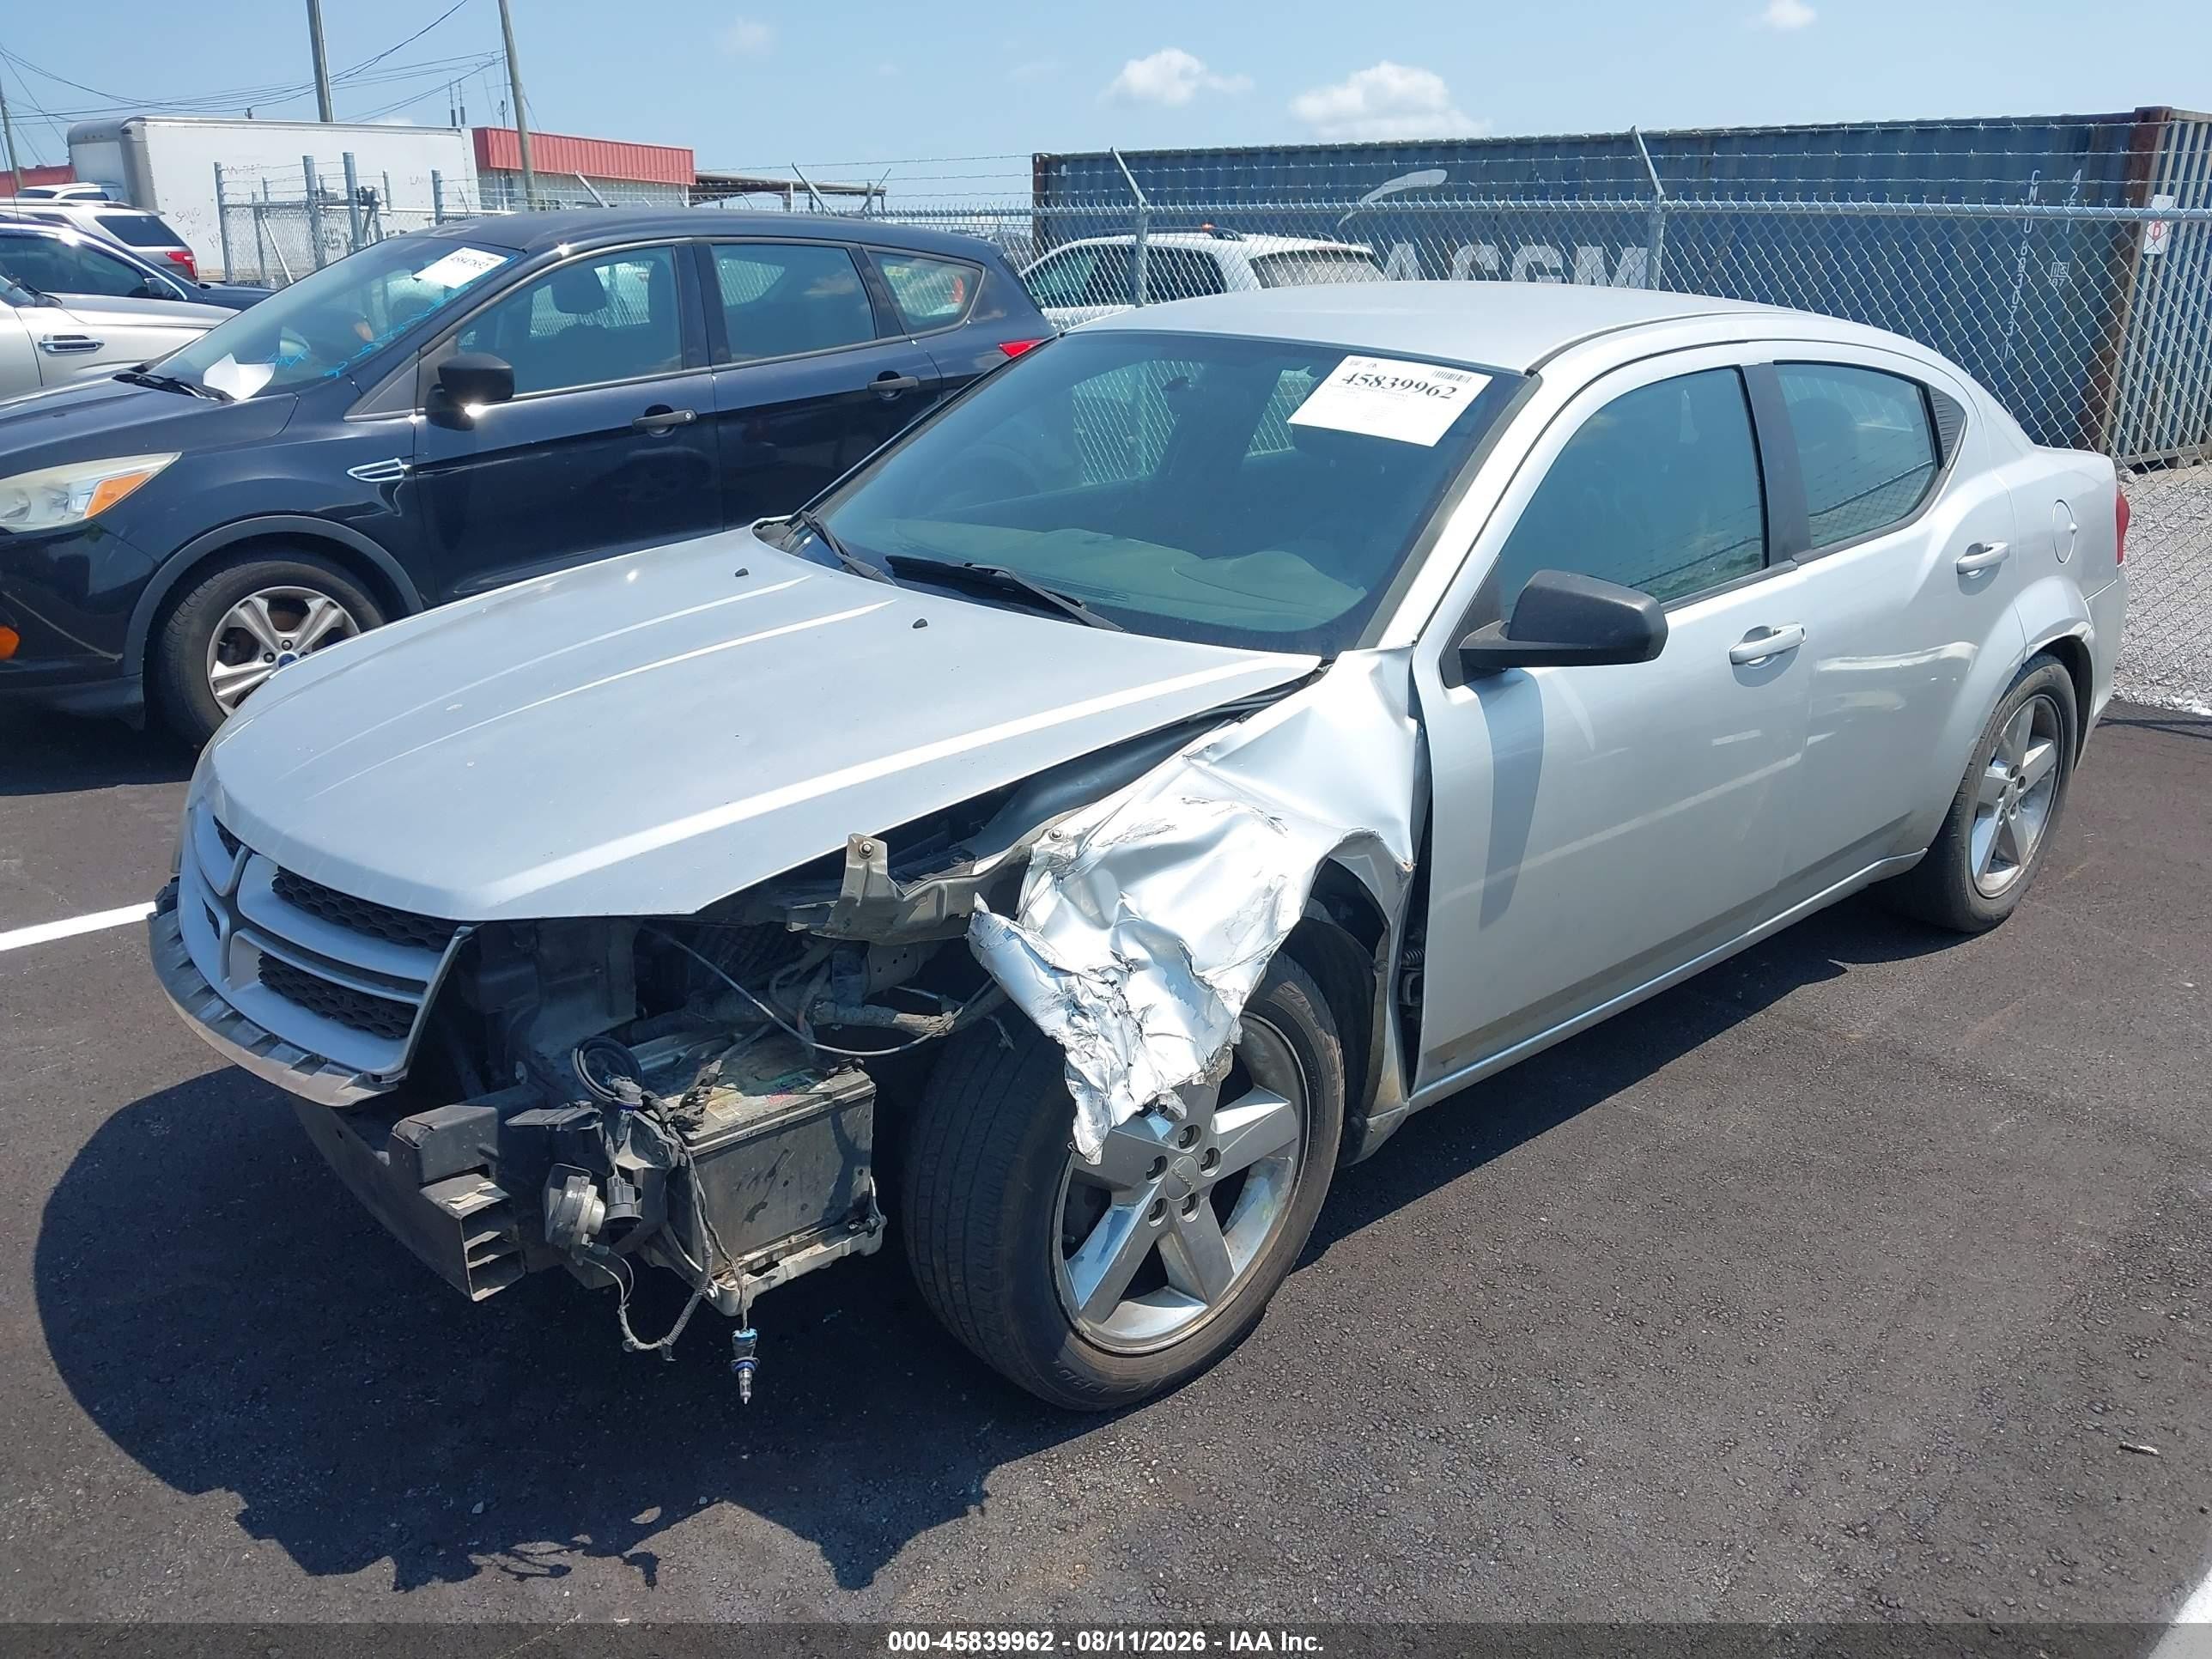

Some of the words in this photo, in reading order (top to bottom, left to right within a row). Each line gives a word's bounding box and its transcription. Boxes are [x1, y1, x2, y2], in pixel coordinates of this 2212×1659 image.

[2024, 170, 2040, 233] CMU
[2066, 169, 2081, 234] 421
[1341, 372, 1457, 398] 45839962
